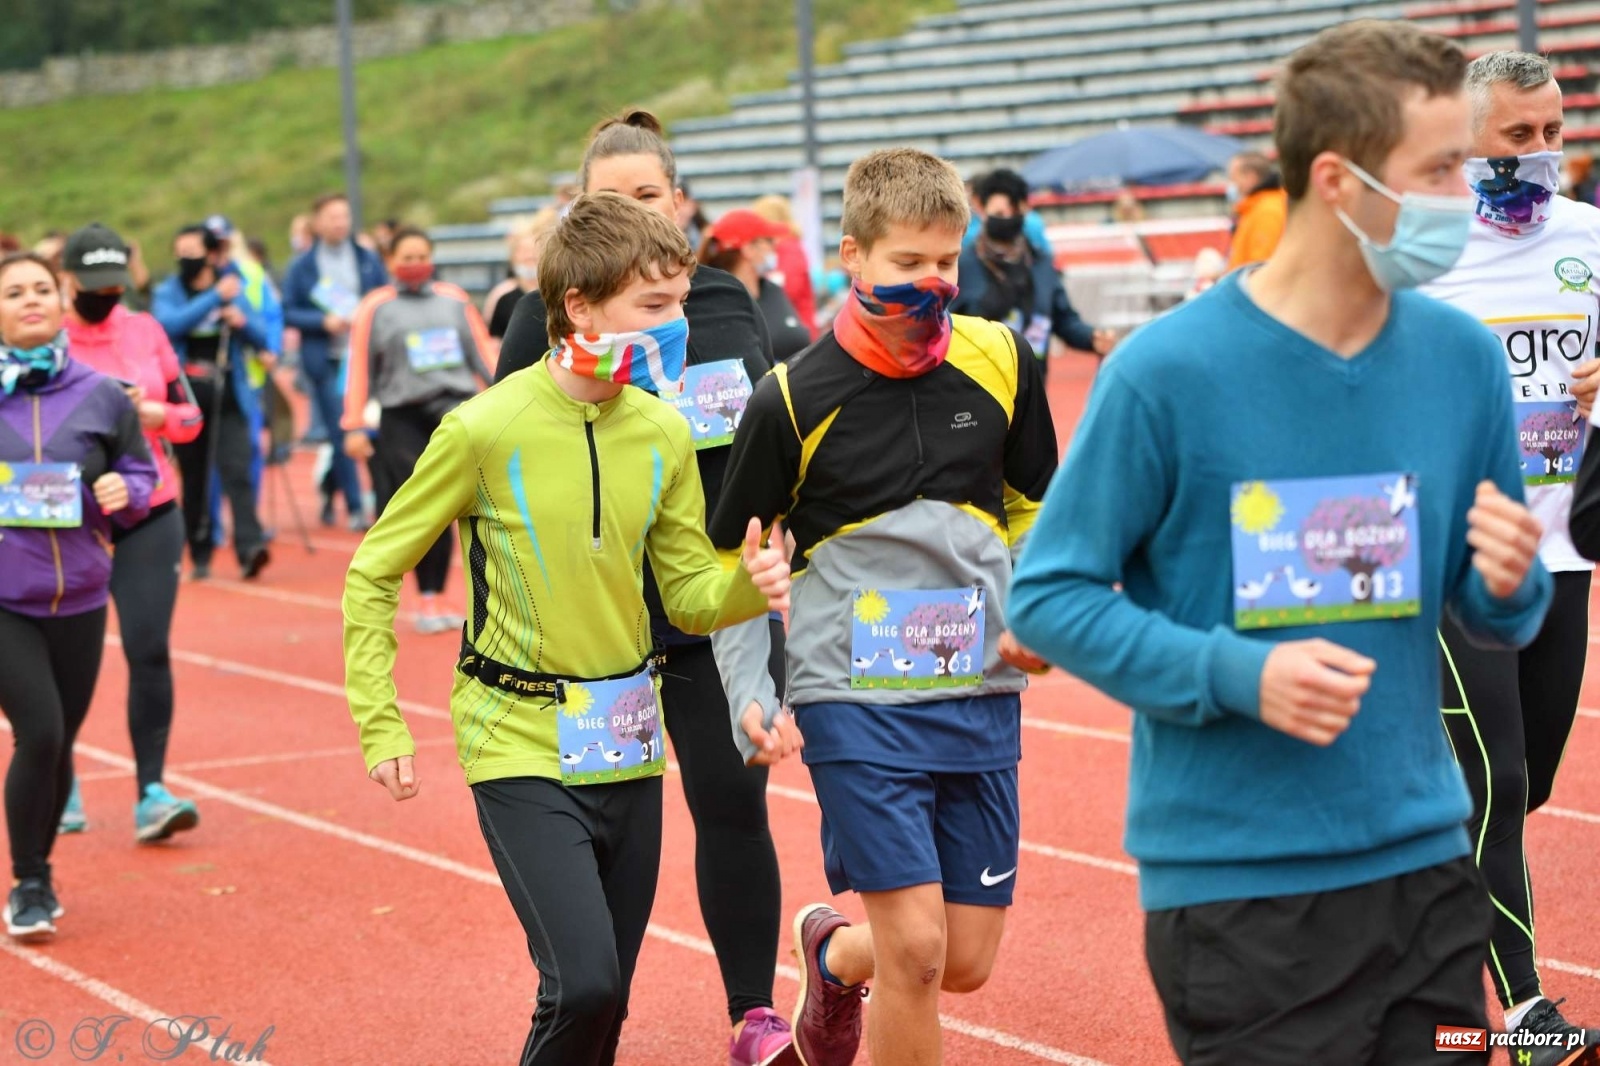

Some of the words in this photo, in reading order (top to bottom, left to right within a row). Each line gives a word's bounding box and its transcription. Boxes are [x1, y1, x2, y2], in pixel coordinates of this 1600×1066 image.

[697, 393, 714, 404] DLA
[1519, 431, 1539, 441] DLA
[1543, 456, 1574, 474] 142
[1304, 529, 1337, 550] DLA
[1351, 571, 1404, 600] 013
[871, 625, 898, 638] BIEG
[905, 625, 928, 637] DLA
[934, 651, 972, 675] 263
[577, 717, 605, 730] BIEG
[612, 713, 633, 727] DLA
[641, 737, 660, 762] 271
